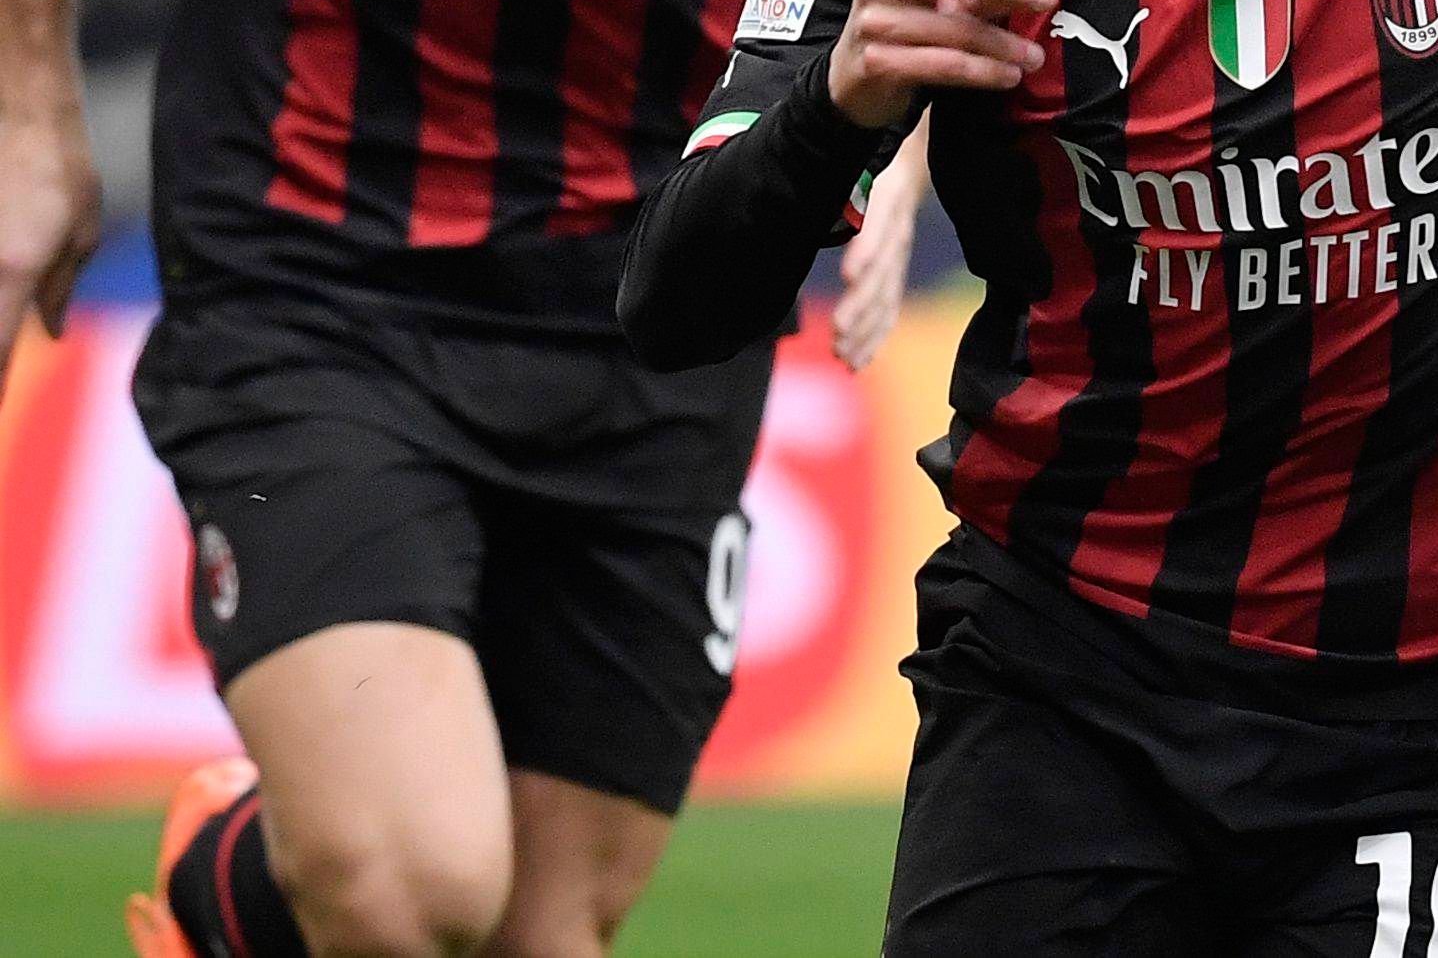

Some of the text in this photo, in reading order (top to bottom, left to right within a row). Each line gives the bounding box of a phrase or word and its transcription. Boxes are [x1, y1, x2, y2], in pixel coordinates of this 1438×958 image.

[1400, 26, 1437, 43] 1899
[1128, 213, 1437, 311] FLY BETTER
[703, 514, 748, 676] 9
